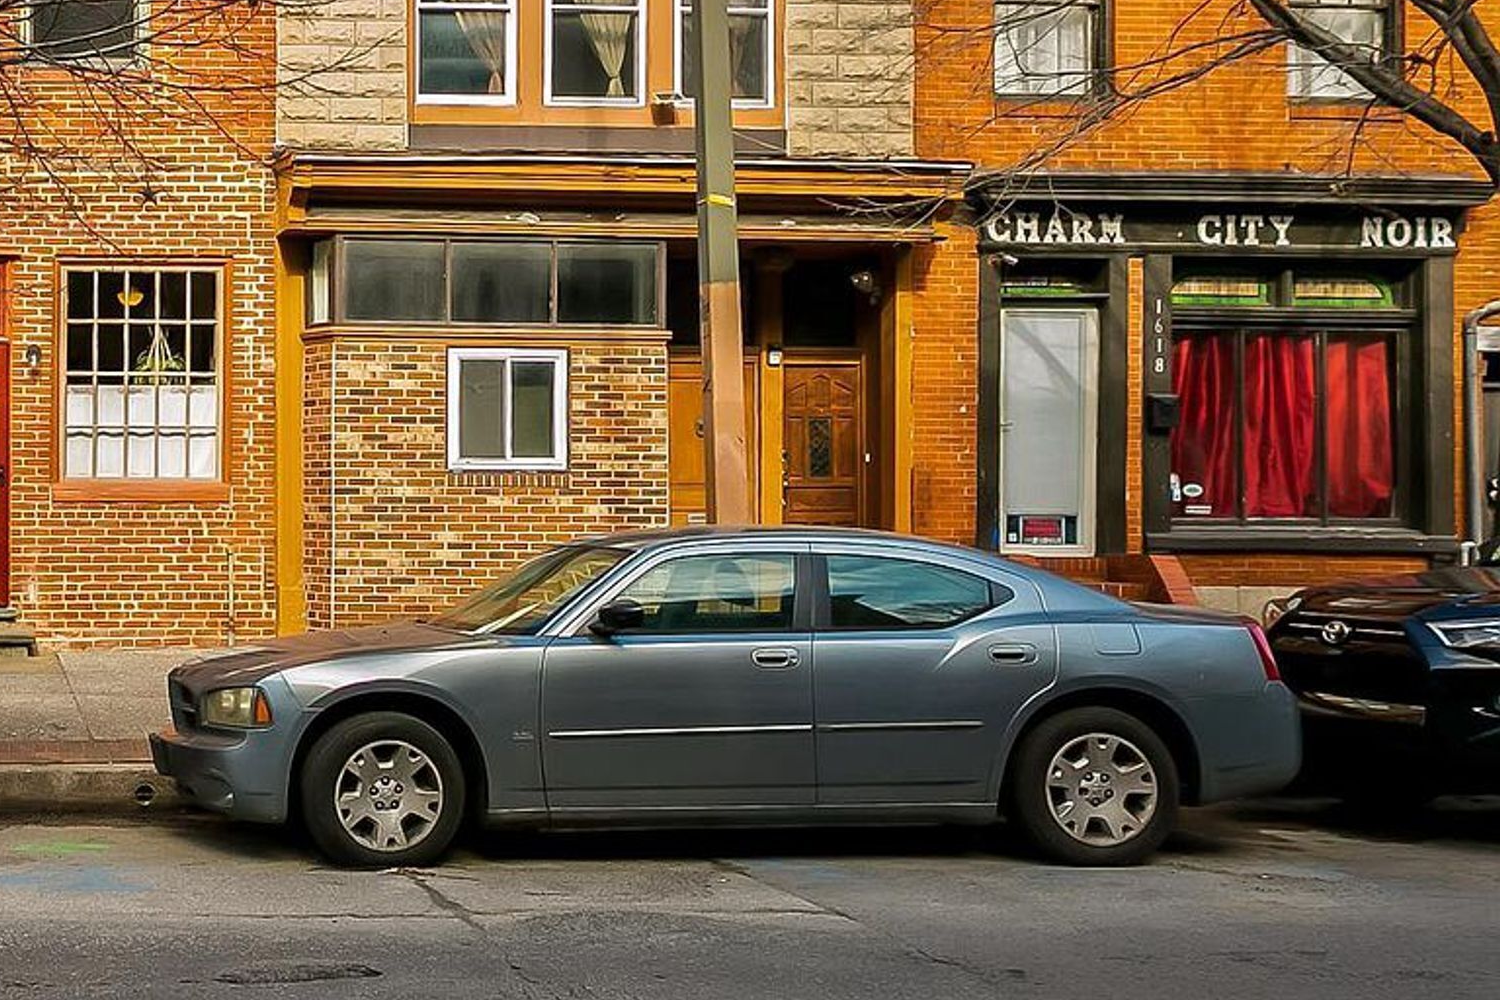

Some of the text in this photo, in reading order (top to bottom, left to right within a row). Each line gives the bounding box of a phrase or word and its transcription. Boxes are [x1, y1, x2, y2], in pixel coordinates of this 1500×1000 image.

[987, 212, 1456, 248] CHARM CITY NOIR
[1154, 298, 1164, 373] 1618
